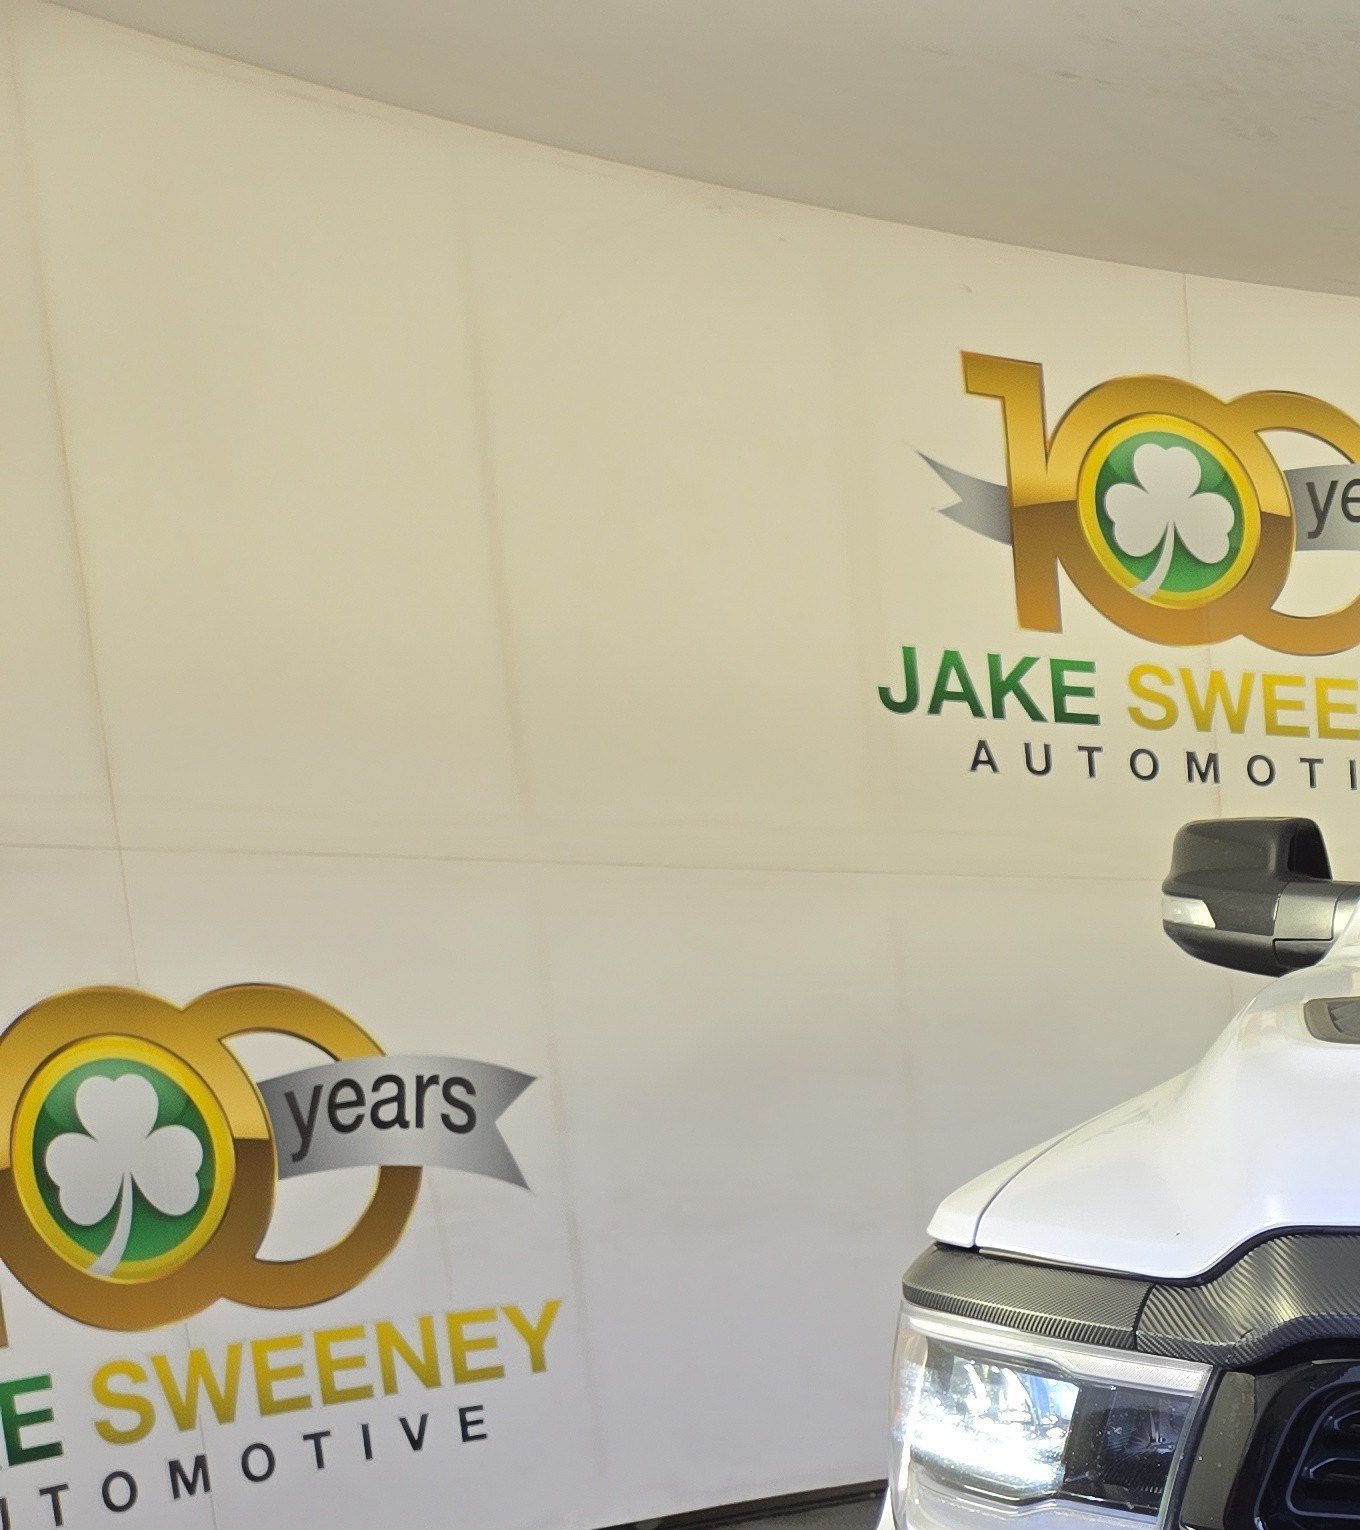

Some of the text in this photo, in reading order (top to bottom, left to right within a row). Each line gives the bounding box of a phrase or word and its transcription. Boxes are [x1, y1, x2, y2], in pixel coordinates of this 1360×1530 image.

[878, 646, 1101, 725] JAKE
[284, 1073, 477, 1161] years
[91, 1300, 563, 1445] SWEENEY
